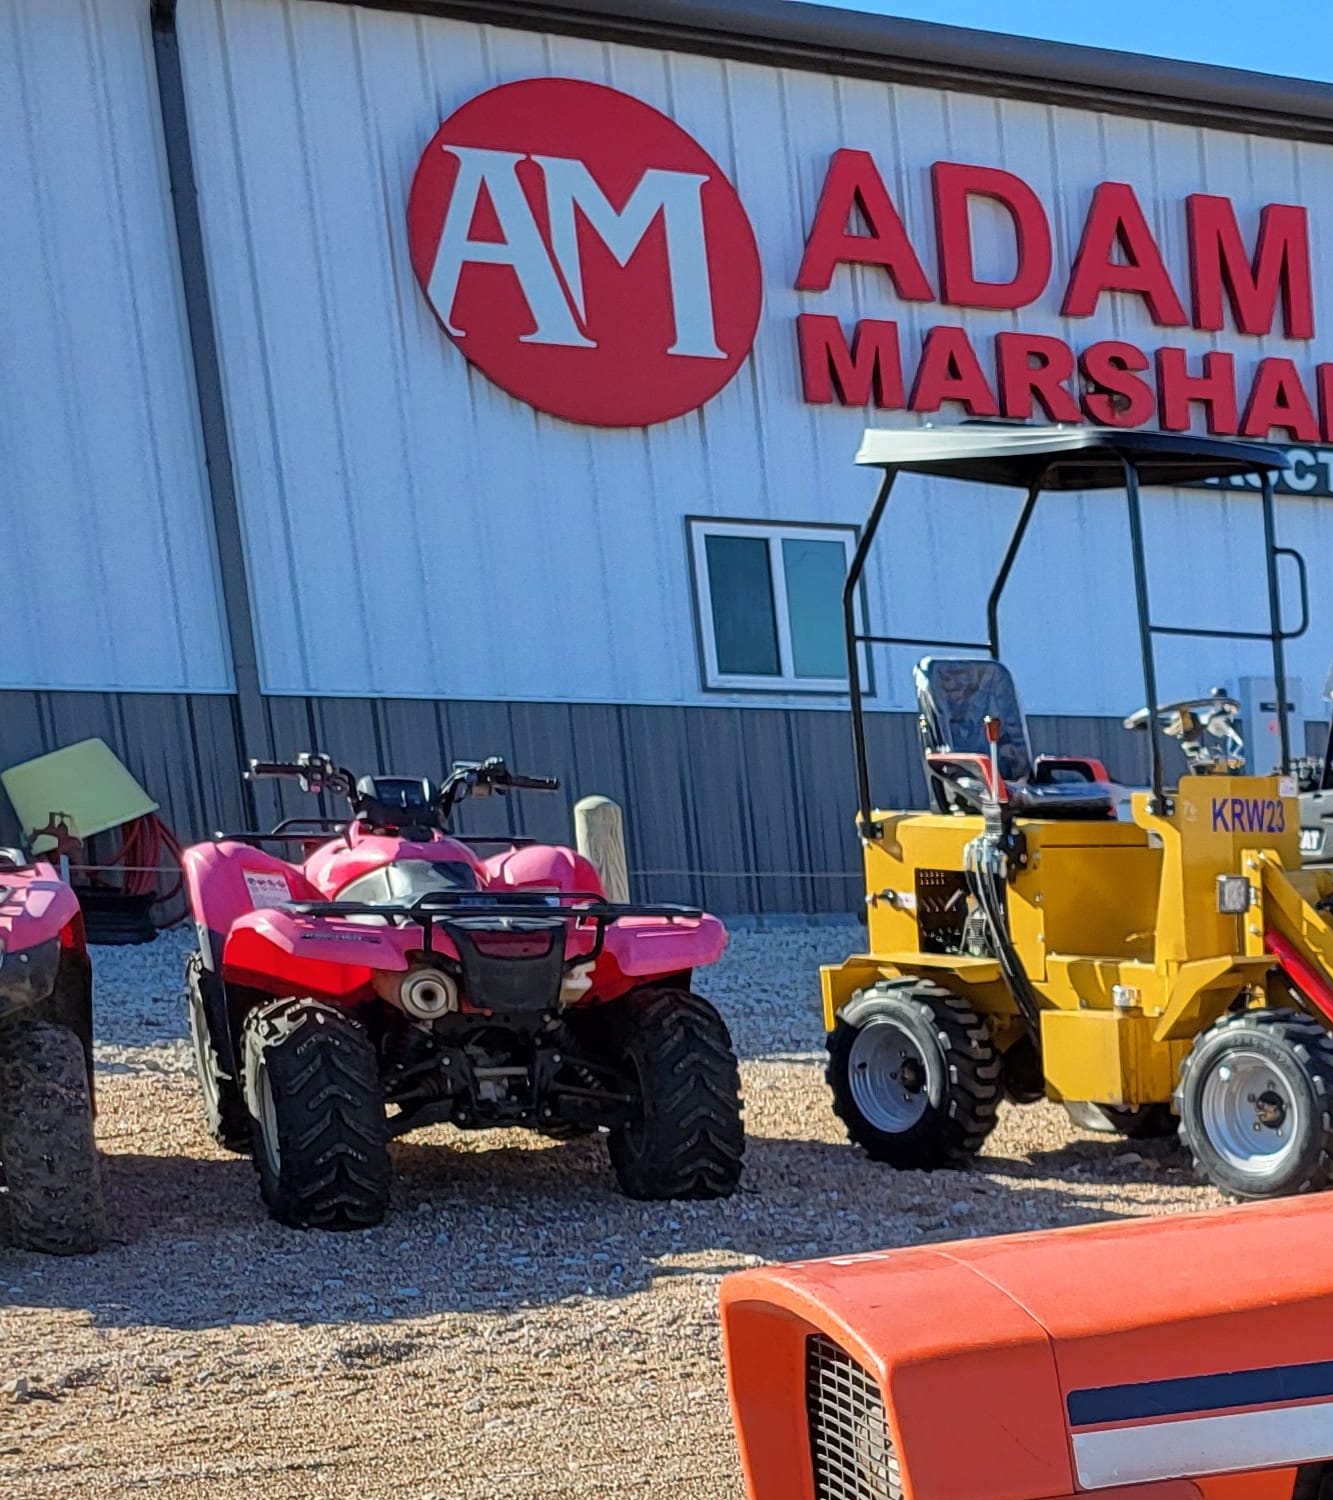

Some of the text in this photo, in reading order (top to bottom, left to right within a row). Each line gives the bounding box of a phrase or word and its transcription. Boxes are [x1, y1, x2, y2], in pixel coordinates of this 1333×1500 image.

[427, 143, 728, 359] AM
[794, 148, 1315, 340] ADAM
[1211, 797, 1285, 833] KRW23
[1300, 830, 1320, 850] AT
